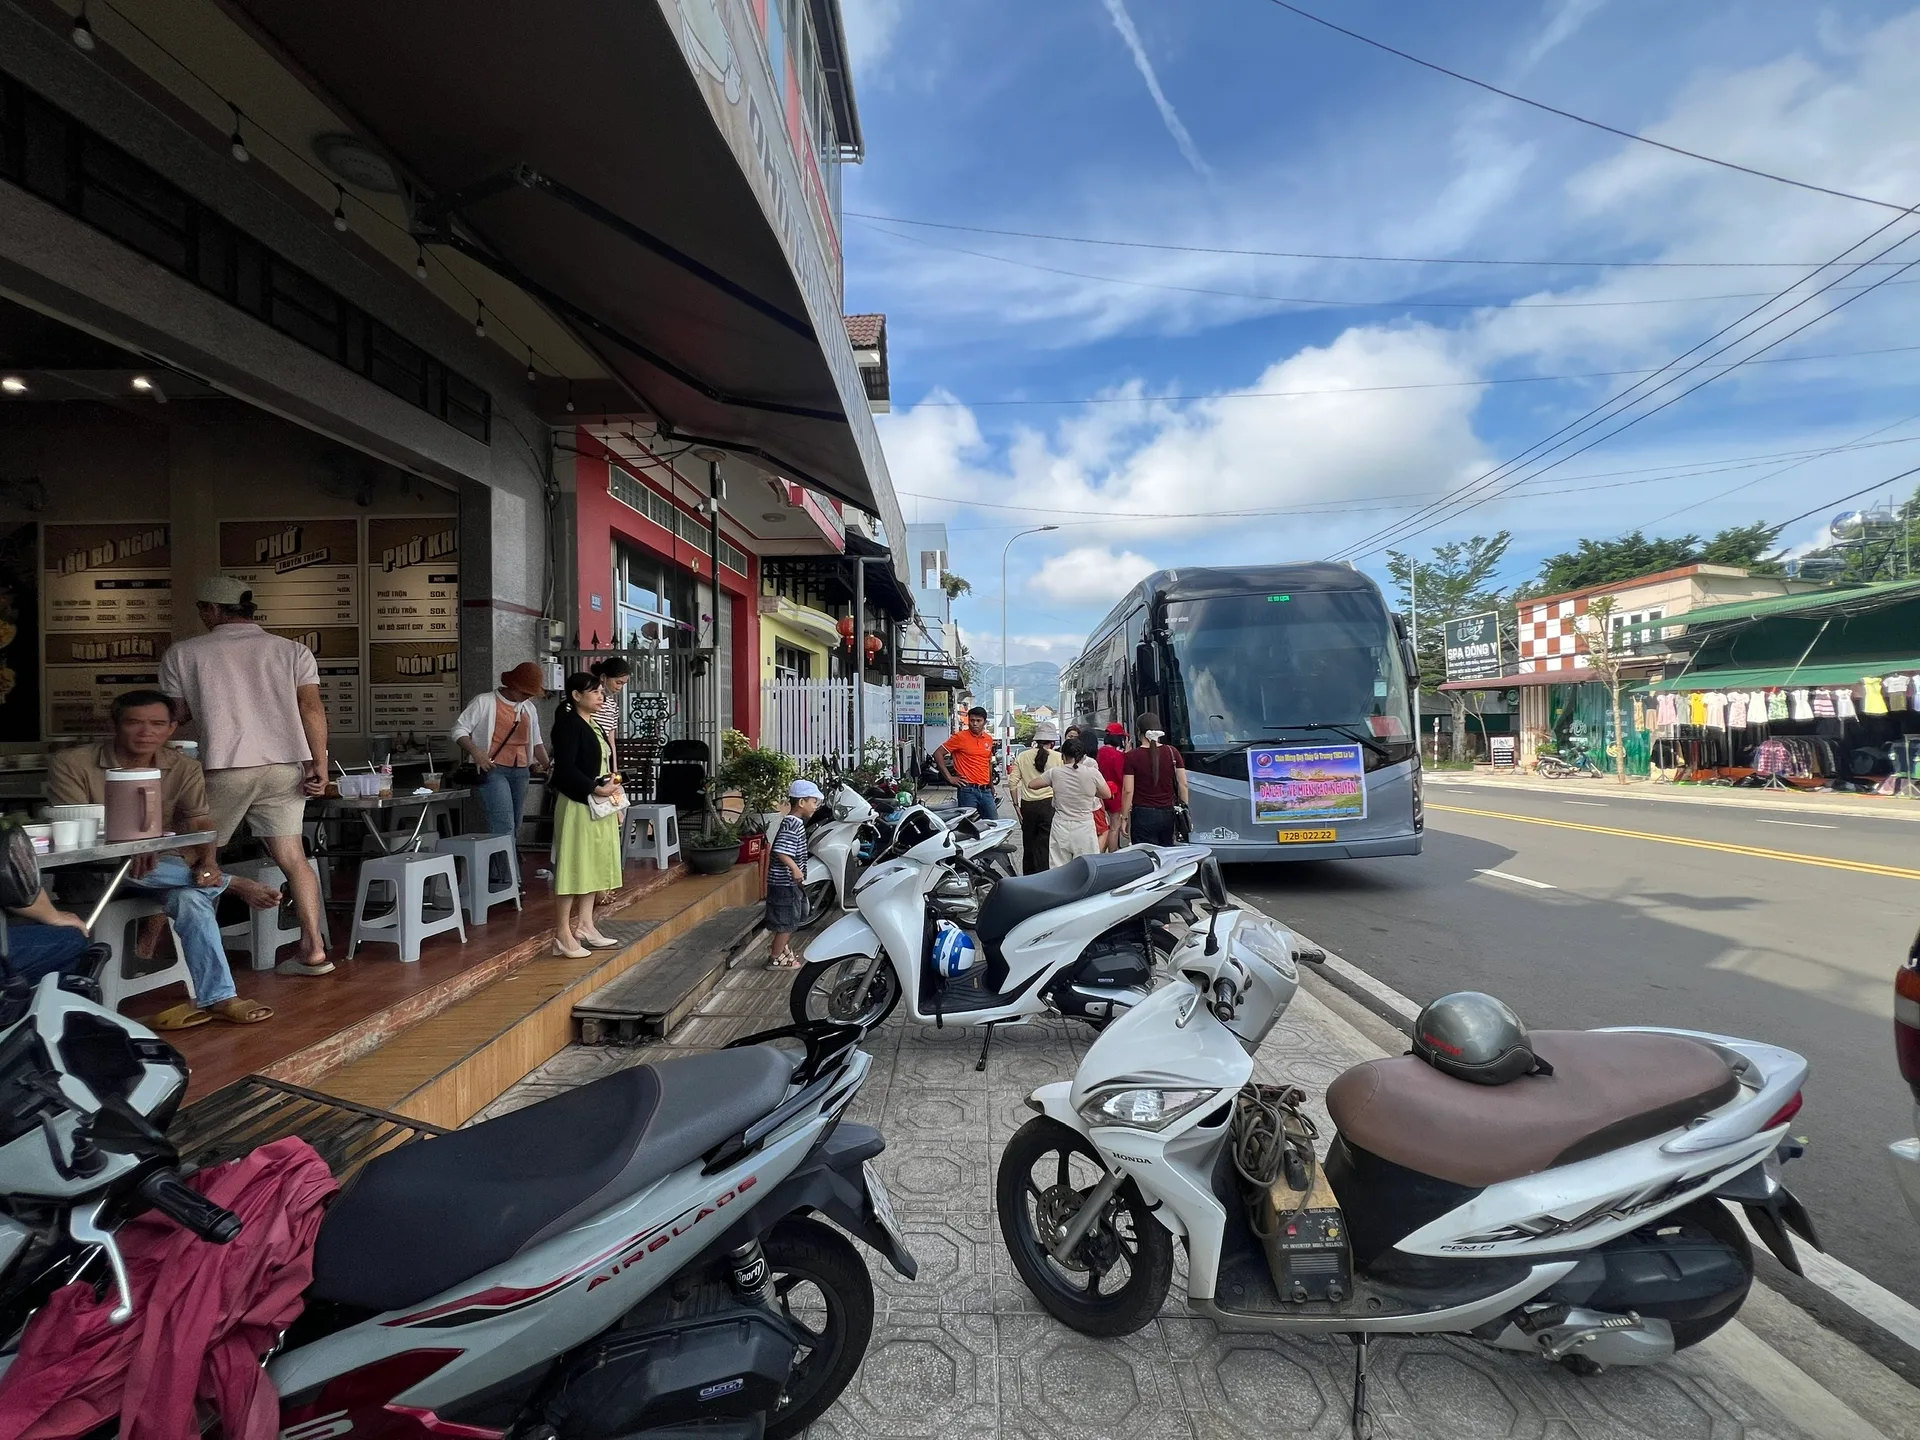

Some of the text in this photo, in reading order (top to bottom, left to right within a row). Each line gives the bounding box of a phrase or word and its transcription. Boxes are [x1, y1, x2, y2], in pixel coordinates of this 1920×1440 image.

[255, 525, 301, 564] PHỞ
[382, 534, 424, 572] PHỞ
[1448, 641, 1498, 660] SPA ĐÔNG Y
[396, 653, 433, 674] MÓN
[1112, 1151, 1153, 1165] HONDA
[586, 1175, 758, 1292] AIRBLADE
[736, 1262, 763, 1283] Sporty
